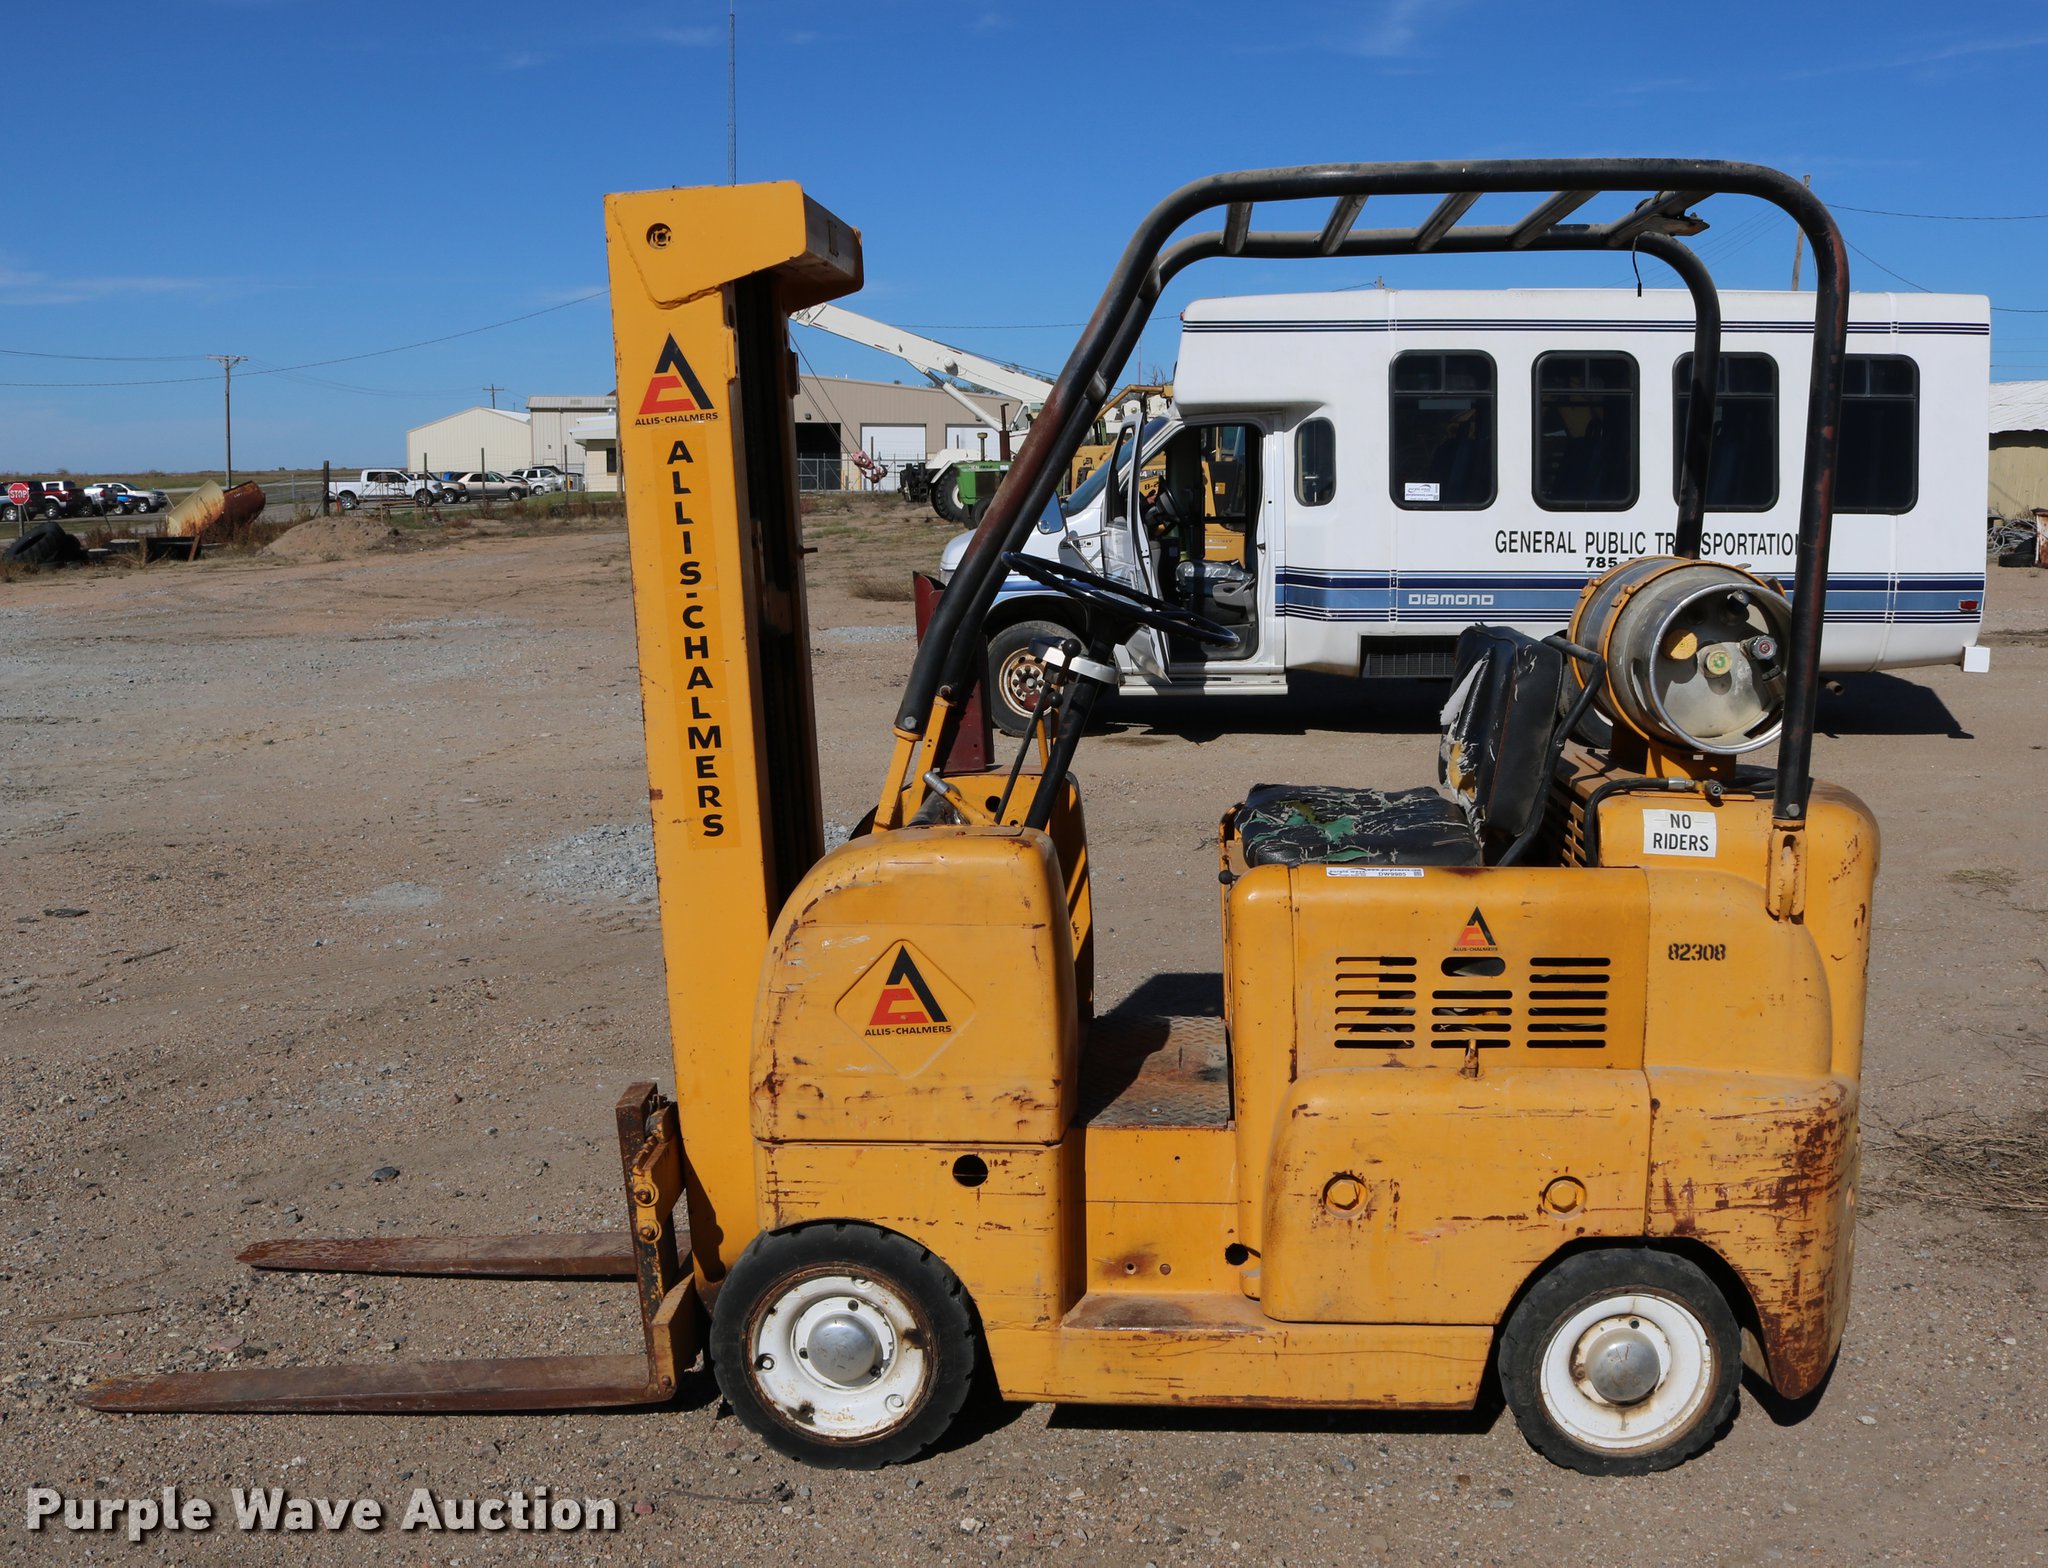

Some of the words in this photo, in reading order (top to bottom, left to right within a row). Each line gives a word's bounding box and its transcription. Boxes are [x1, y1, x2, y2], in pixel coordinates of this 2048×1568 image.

[634, 412, 719, 426] ALLIS-CHALMERS
[10, 490, 27, 498] STOP
[1495, 530, 1577, 554] GENERAL
[1585, 531, 1646, 555] PUBLIC
[1655, 532, 1800, 556] TRSPORTATIO
[667, 440, 724, 837] ALLIS-CHALMERS
[1670, 814, 1692, 830] NO
[1653, 833, 1709, 852] RIDERS
[1668, 943, 1727, 961] 82308
[864, 1025, 952, 1036] ALLIS-CHALMERS
